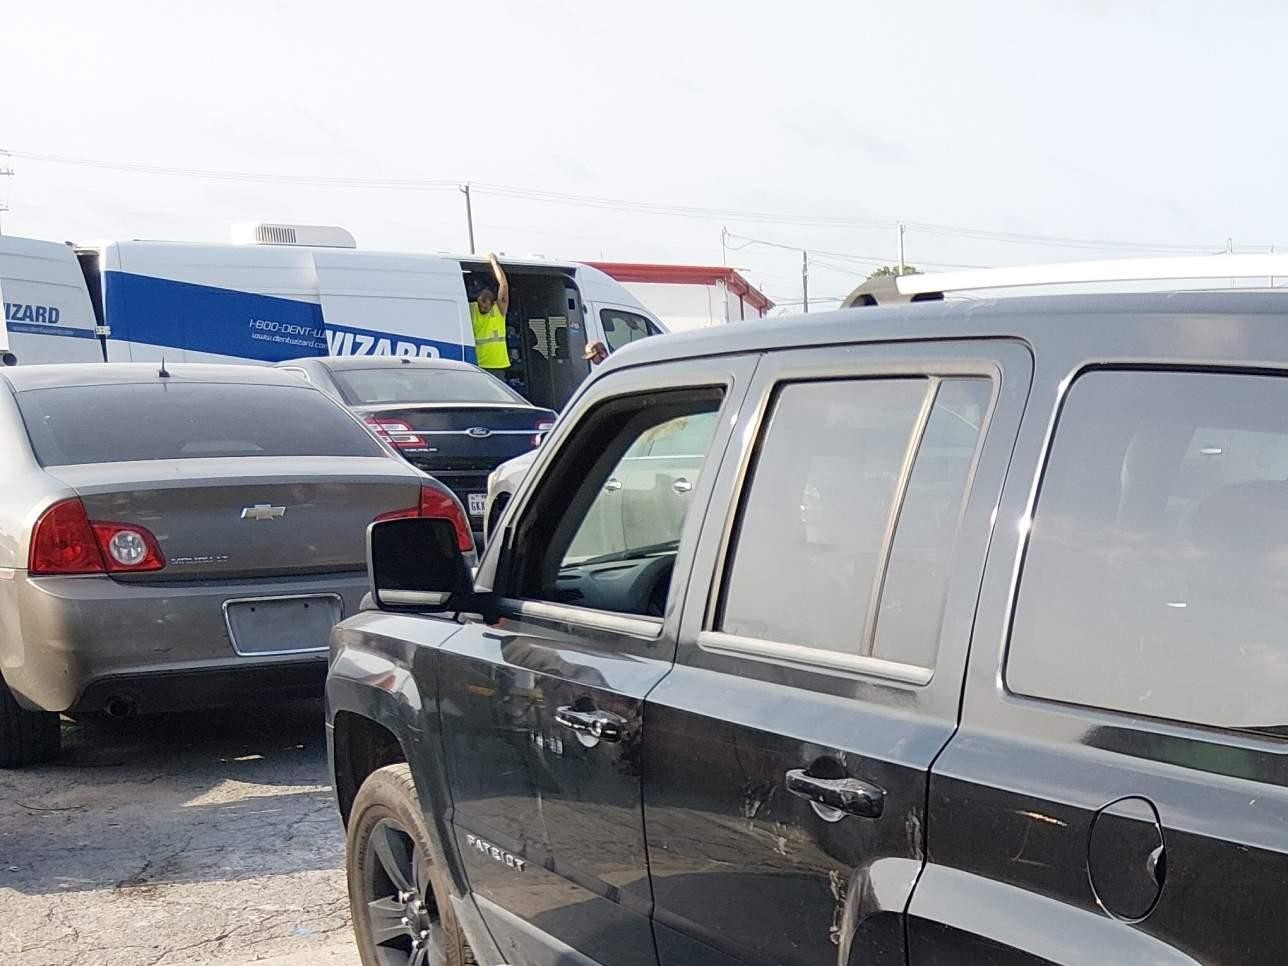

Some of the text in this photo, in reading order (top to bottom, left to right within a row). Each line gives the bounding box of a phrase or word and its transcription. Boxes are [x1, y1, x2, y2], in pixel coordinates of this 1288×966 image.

[4, 303, 60, 324] IZARD
[249, 318, 326, 338] 1-800-DENT-W
[466, 834, 526, 872] PATRIOT
